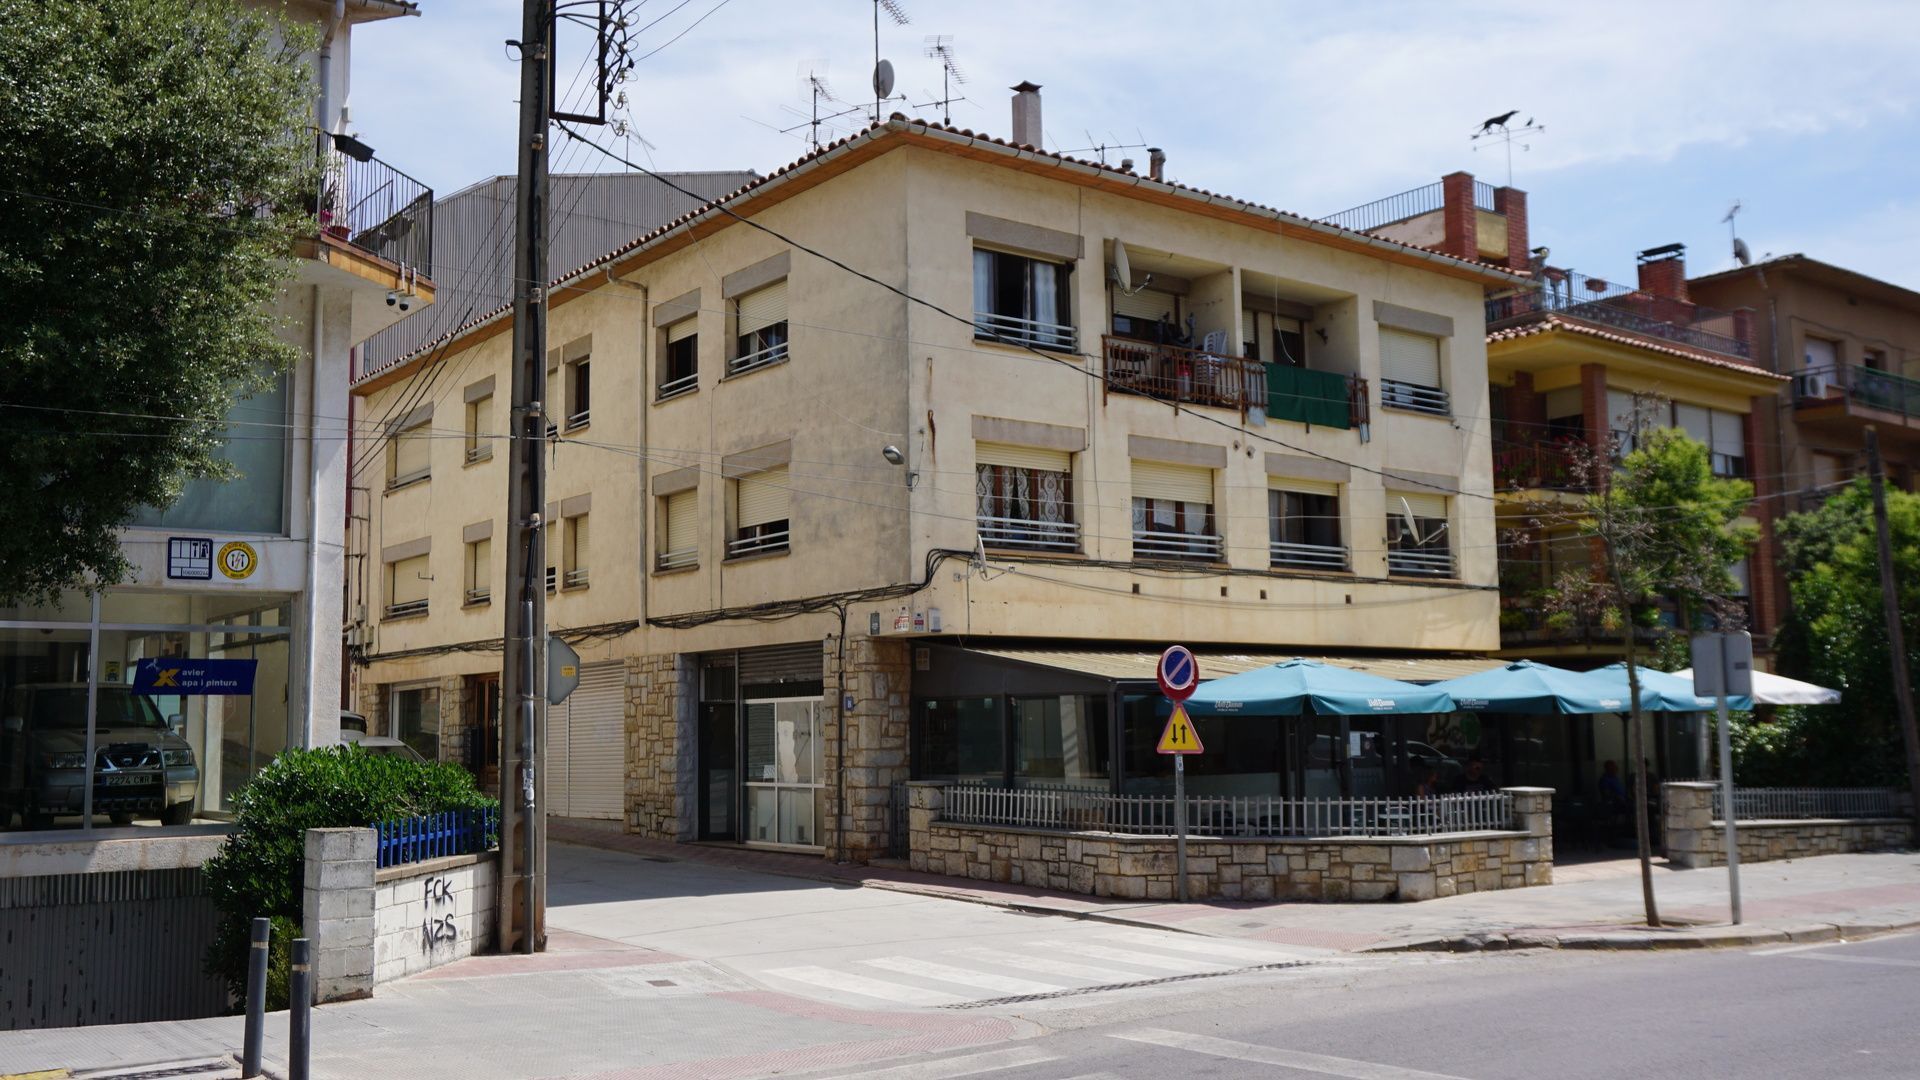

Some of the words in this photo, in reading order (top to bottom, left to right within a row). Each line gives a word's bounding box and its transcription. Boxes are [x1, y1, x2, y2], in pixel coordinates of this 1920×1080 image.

[206, 680, 238, 688] pintura
[424, 877, 454, 910] FCK
[422, 913, 457, 955] NZS
